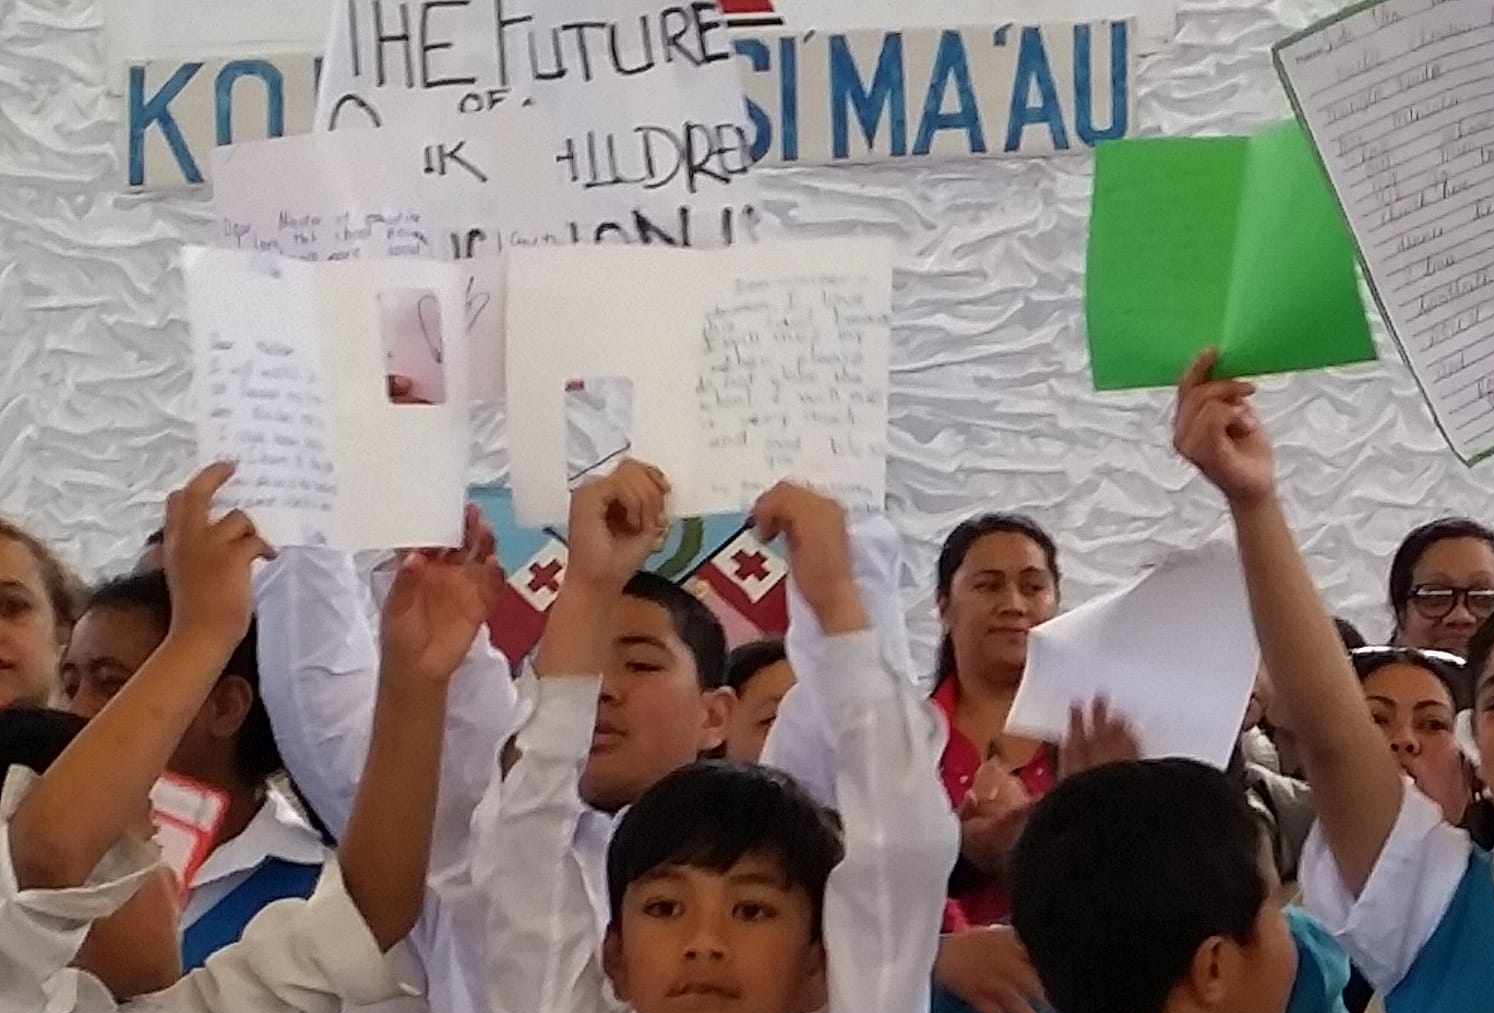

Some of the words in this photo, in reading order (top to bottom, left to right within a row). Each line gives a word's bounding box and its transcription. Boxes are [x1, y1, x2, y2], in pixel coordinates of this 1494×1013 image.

[347, 0, 476, 88] THE
[496, 0, 732, 92] FUTURE
[457, 88, 512, 113] OF
